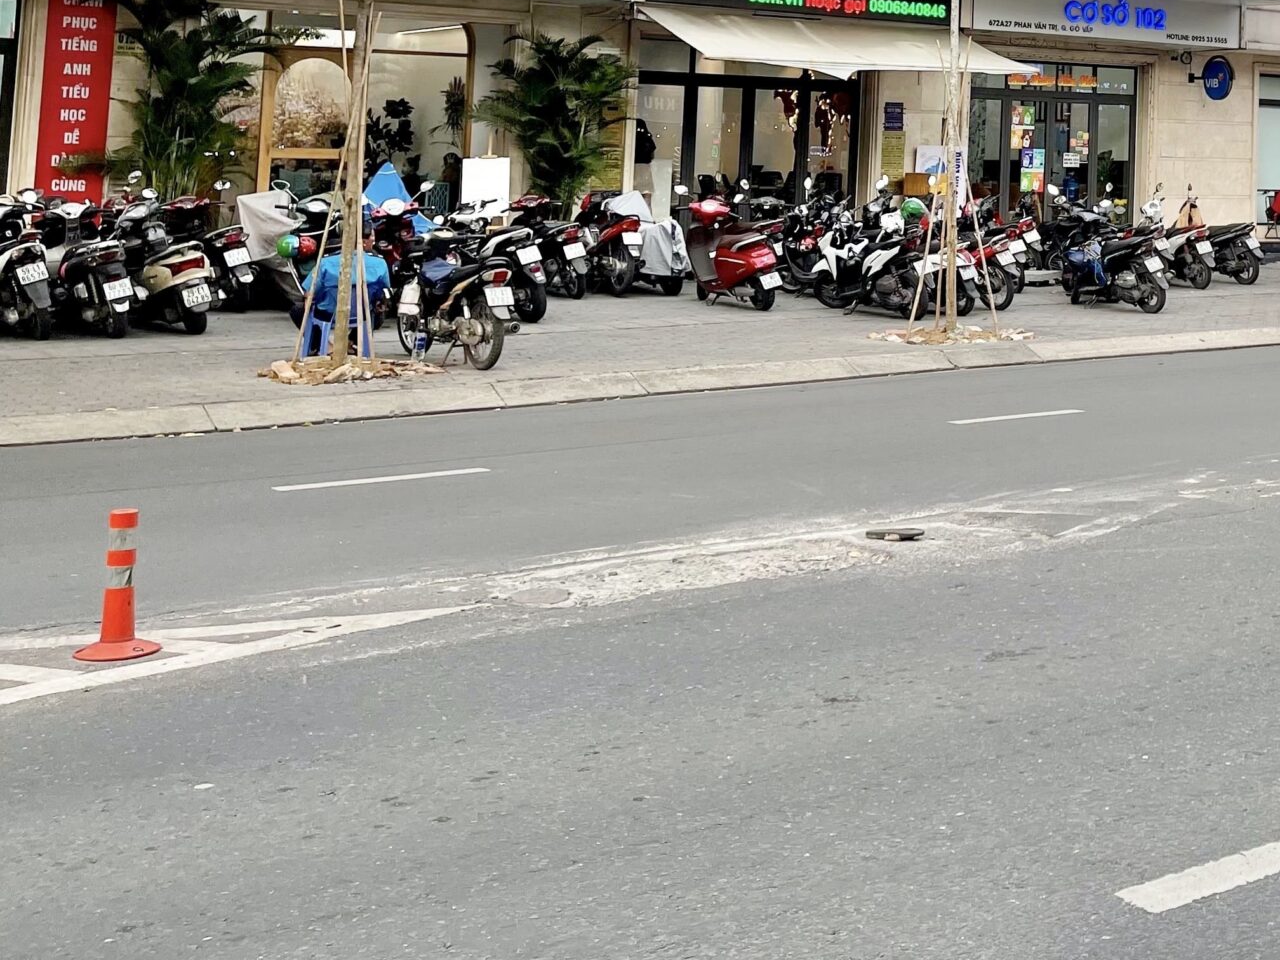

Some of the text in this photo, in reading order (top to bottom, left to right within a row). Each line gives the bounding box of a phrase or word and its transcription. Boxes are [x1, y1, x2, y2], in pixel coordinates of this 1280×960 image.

[1064, 0, 1098, 24] CƠ
[1136, 7, 1166, 30] 102
[62, 17, 97, 31] PHỤC
[60, 34, 98, 52] TIẾNG
[63, 64, 91, 76] ANH
[1205, 78, 1219, 88] VIB
[60, 109, 86, 124] HỌC
[51, 175, 86, 191] CÙNG
